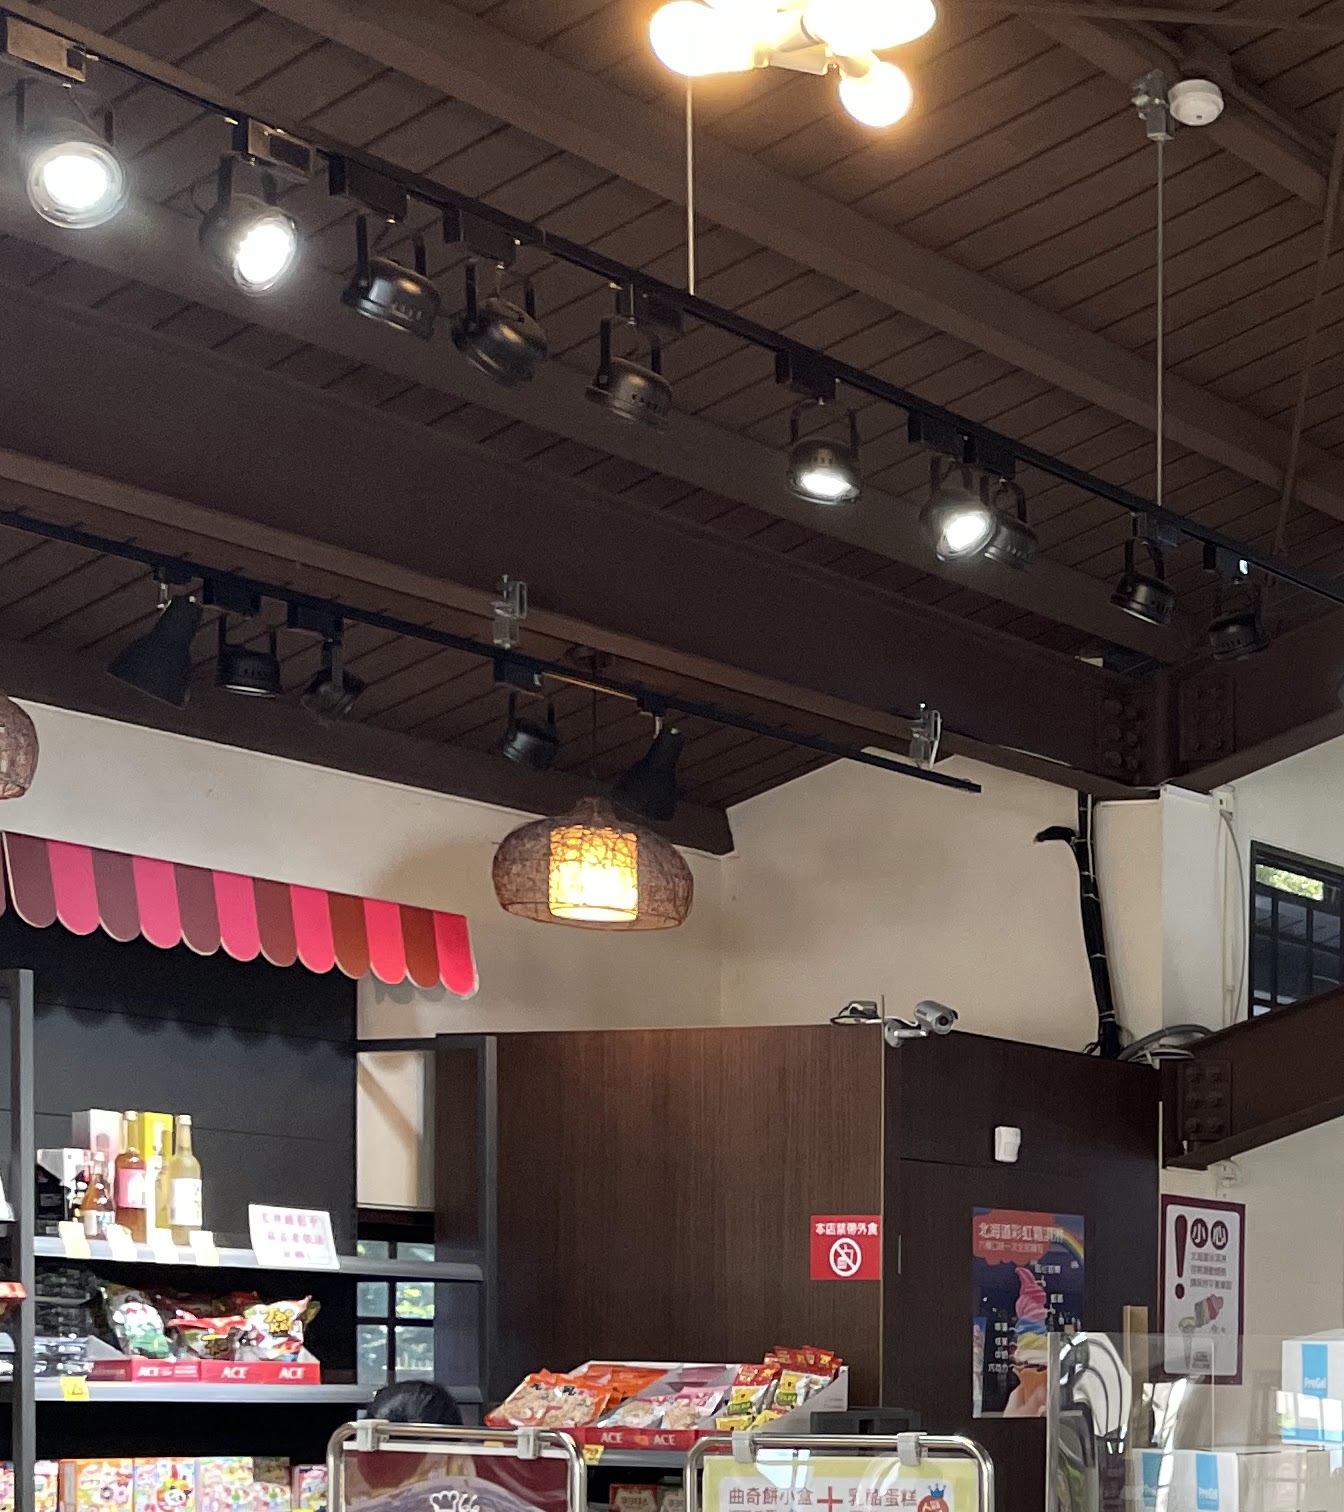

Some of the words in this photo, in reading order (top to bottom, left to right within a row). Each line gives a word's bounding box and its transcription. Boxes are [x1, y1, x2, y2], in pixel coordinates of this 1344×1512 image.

[1191, 1222, 1228, 1248] 小心
[221, 1366, 248, 1379] ACE
[279, 1366, 305, 1379] ACE
[600, 1432, 623, 1445] ACE
[653, 1433, 675, 1446] ACE
[729, 1487, 813, 1505] 曲奇餅小盒
